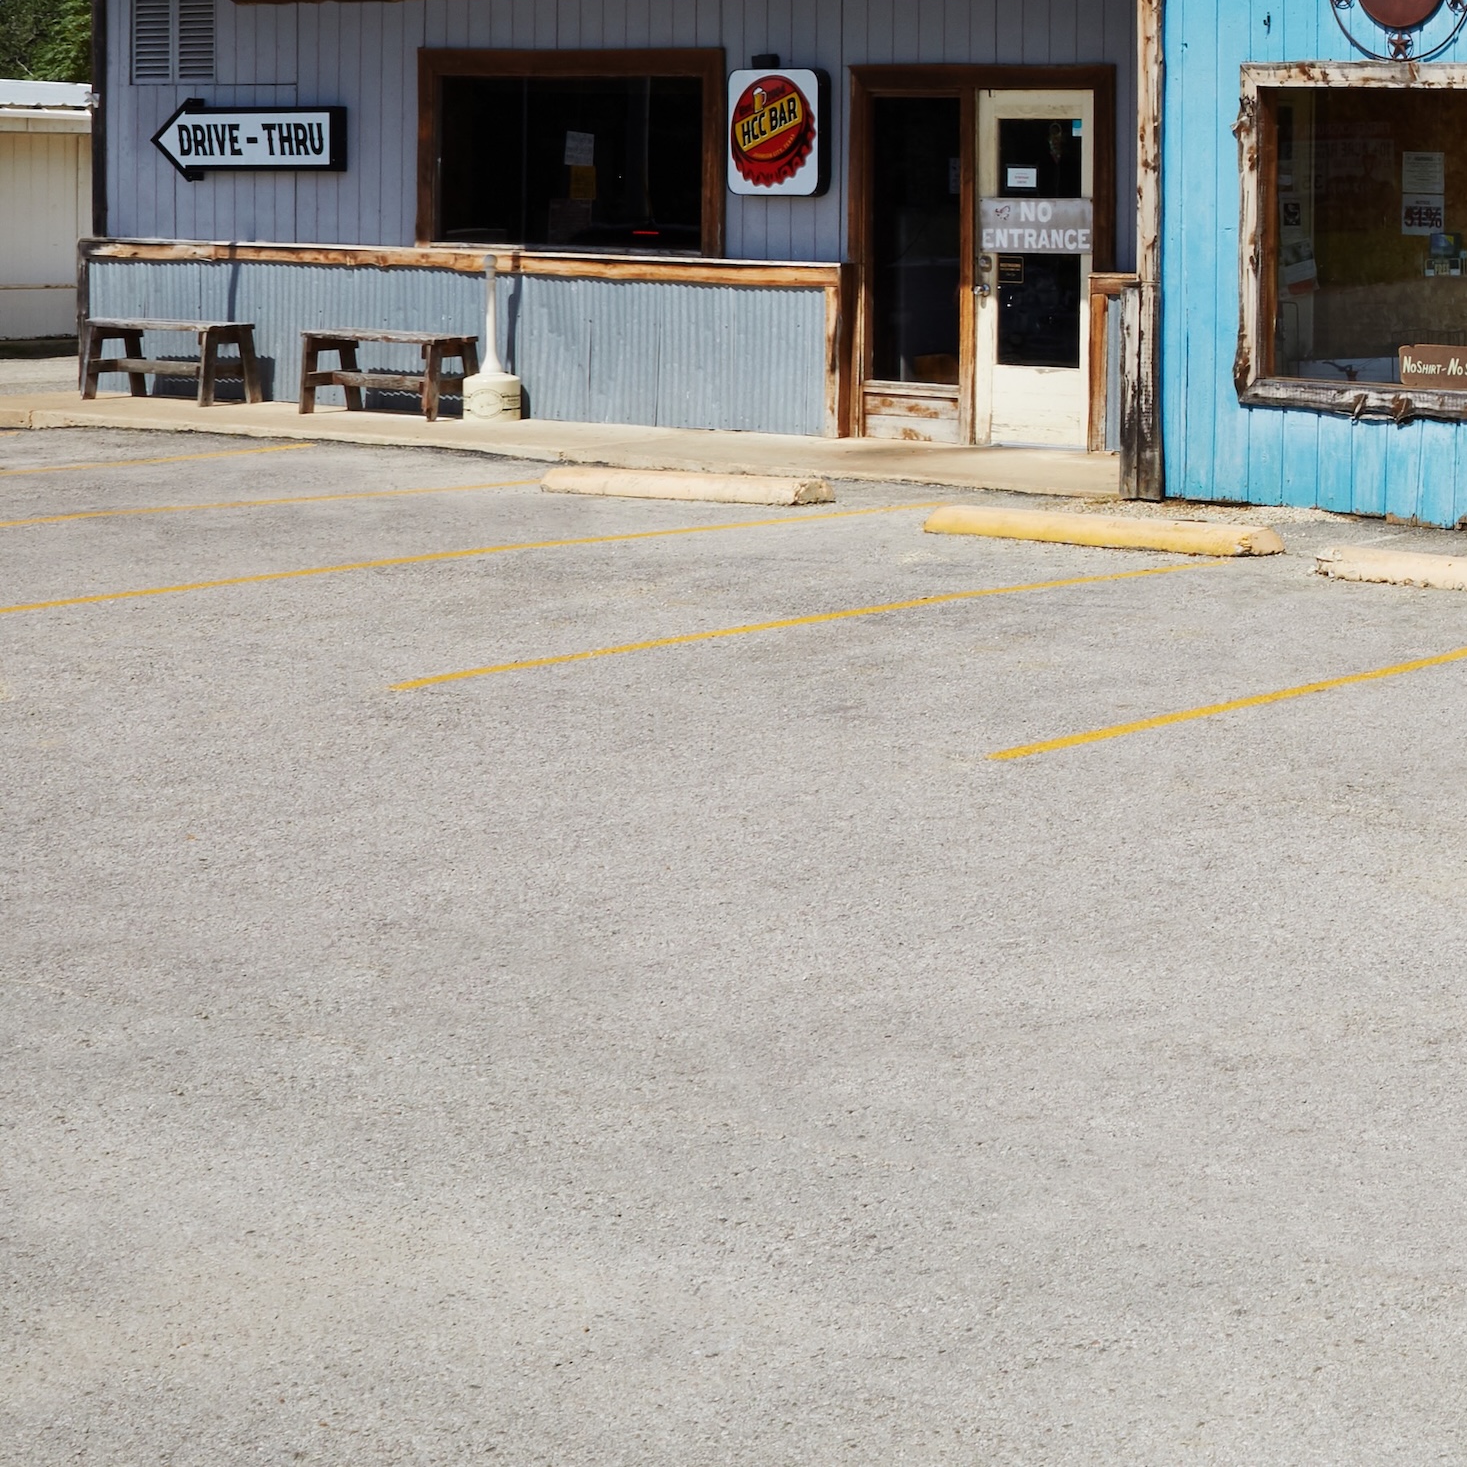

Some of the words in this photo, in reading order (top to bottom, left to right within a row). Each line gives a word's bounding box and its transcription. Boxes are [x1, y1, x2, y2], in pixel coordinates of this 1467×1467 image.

[741, 112, 768, 148] HCC
[769, 97, 798, 133] BAR
[177, 124, 243, 156] DRIVE
[261, 123, 324, 156] THRU
[1020, 202, 1052, 223] NO
[982, 228, 1090, 250] ENTRANCE
